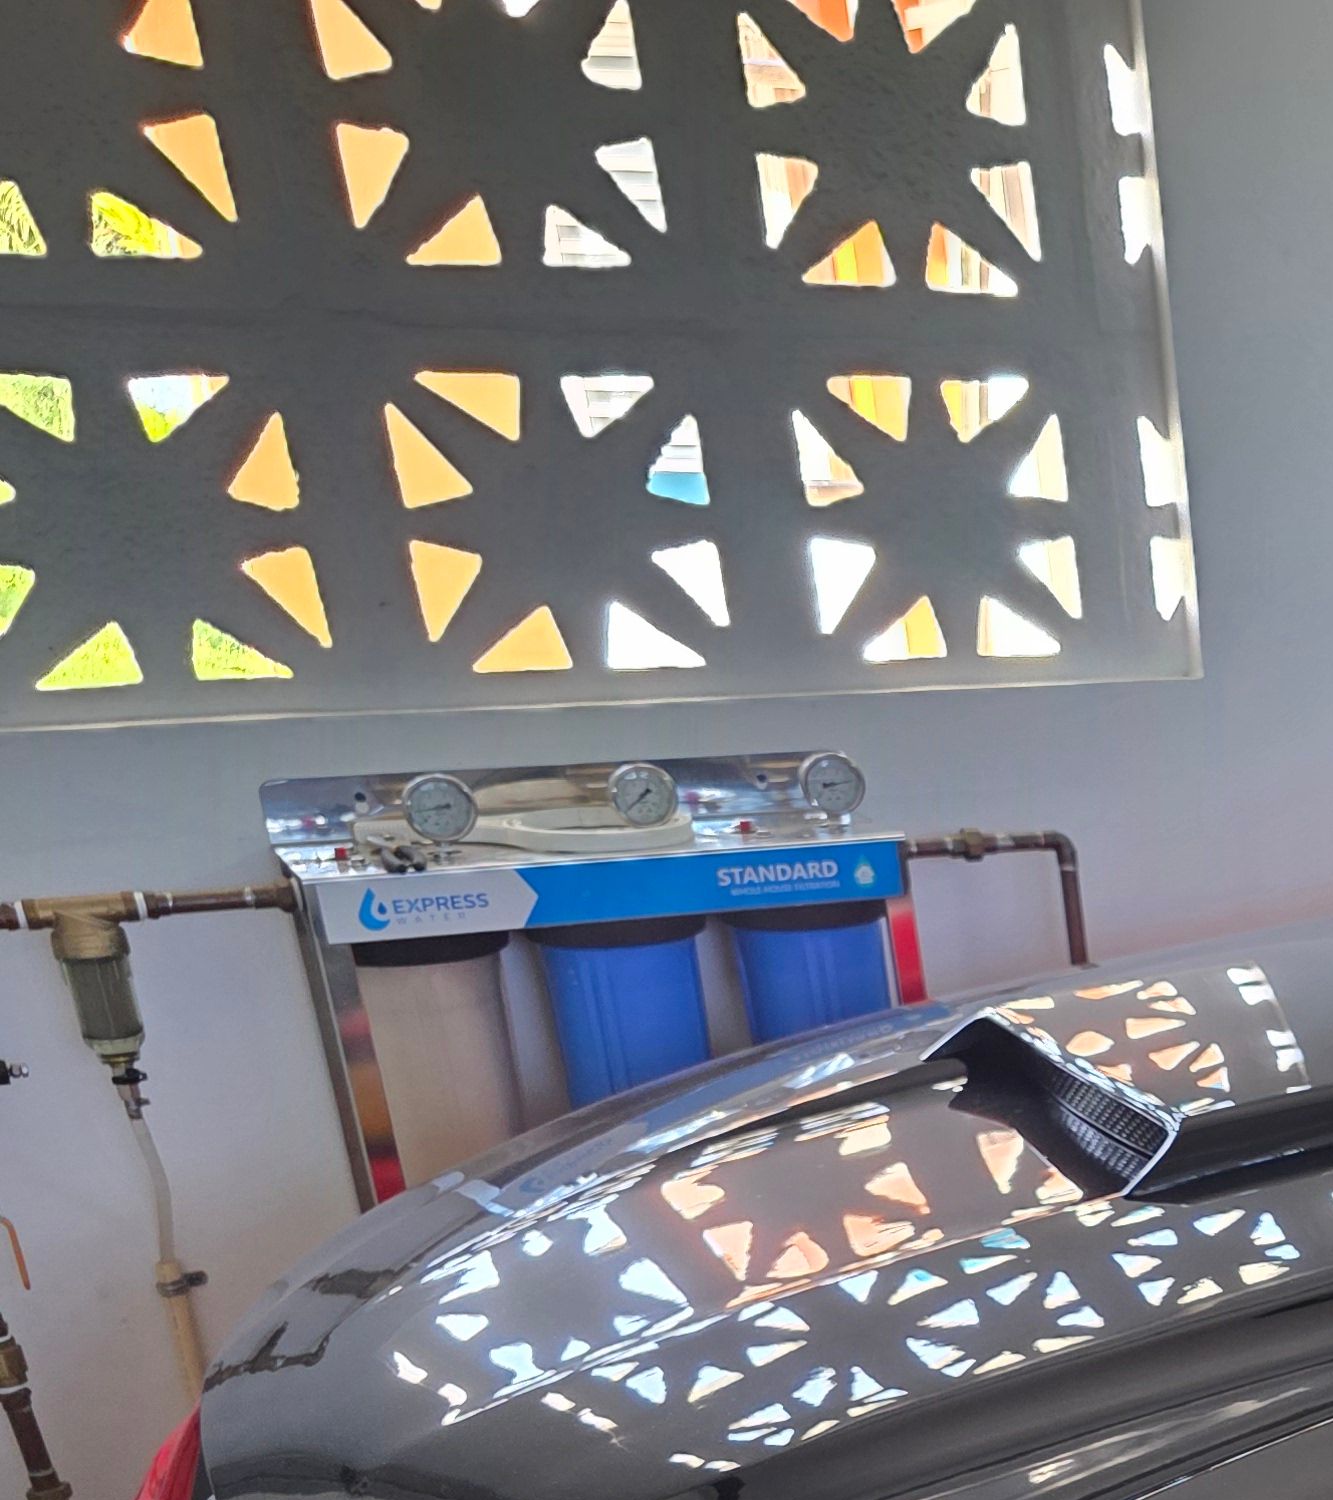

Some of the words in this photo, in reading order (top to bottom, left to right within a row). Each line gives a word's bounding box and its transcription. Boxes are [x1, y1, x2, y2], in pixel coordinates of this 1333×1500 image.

[716, 858, 839, 887] STANDARD
[392, 892, 490, 915] EXPRESS
[395, 911, 467, 925] WATER
